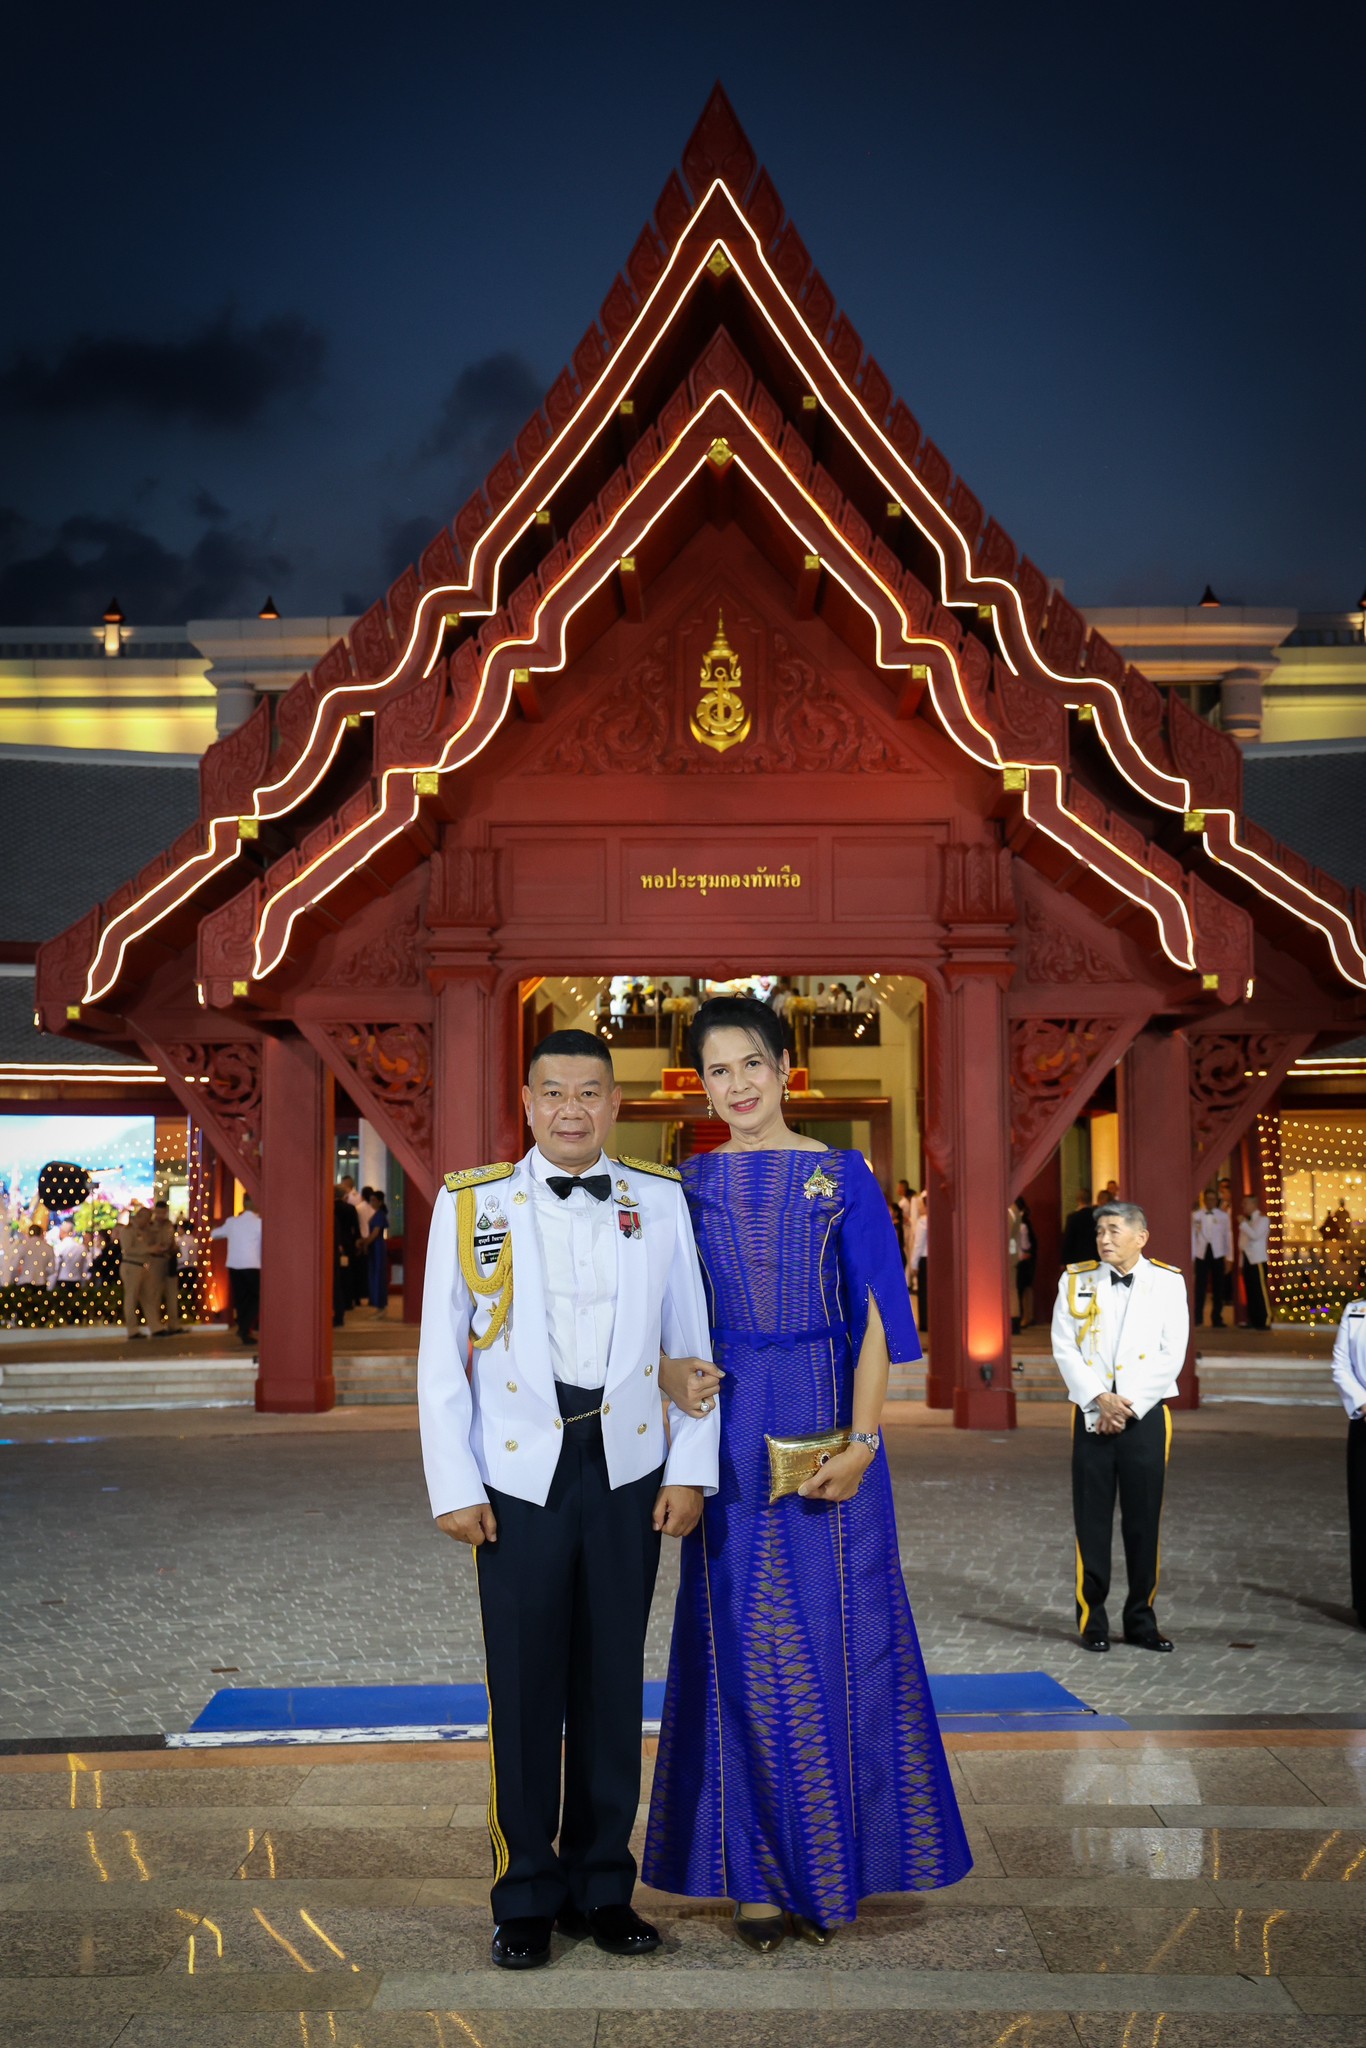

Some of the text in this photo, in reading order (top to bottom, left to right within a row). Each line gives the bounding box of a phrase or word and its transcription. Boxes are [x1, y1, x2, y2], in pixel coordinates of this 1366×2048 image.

[640, 864, 801, 896] หอประชุมกองทัพเรือ
